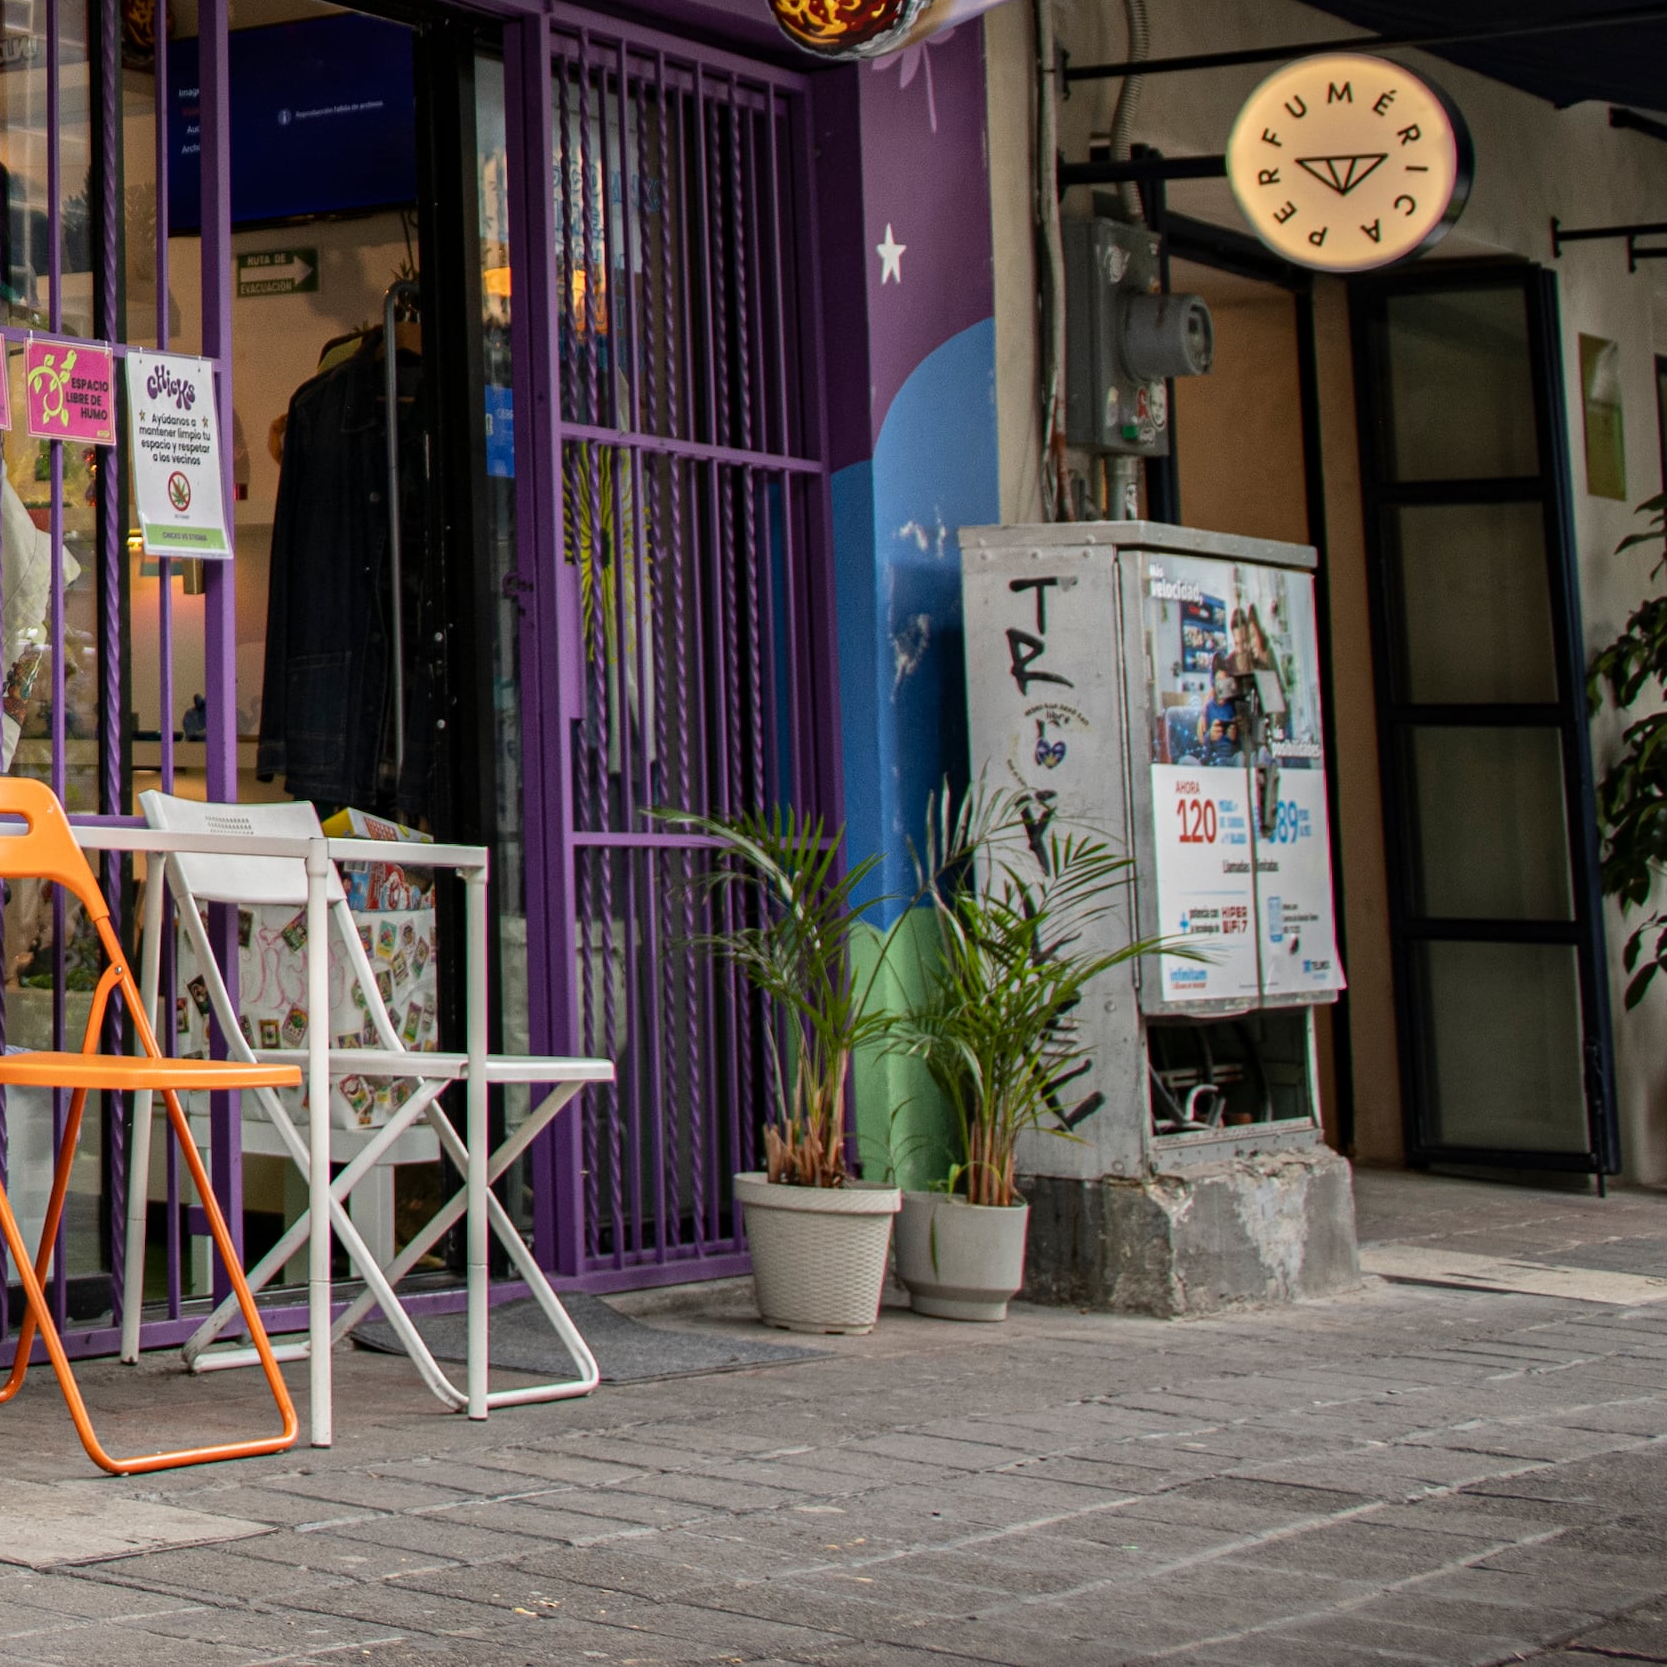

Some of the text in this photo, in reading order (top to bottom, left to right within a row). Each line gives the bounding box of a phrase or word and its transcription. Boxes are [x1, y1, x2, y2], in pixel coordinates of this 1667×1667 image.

[1257, 81, 1429, 248] PERFUMÉRICA
[247, 253, 287, 266] RUTA DE
[71, 378, 109, 392] ESPACIO
[66, 392, 102, 406] LIBRE DE
[80, 407, 108, 420] HUMO
[152, 413, 197, 427] Ayúdanos a
[139, 425, 211, 442] mantener limpio tu
[141, 439, 210, 454] espacio y respetar
[152, 452, 201, 465] a los vecinos
[1175, 781, 1201, 795] AHORA
[1177, 798, 1217, 844] 120
[1221, 906, 1248, 919] HIPER
